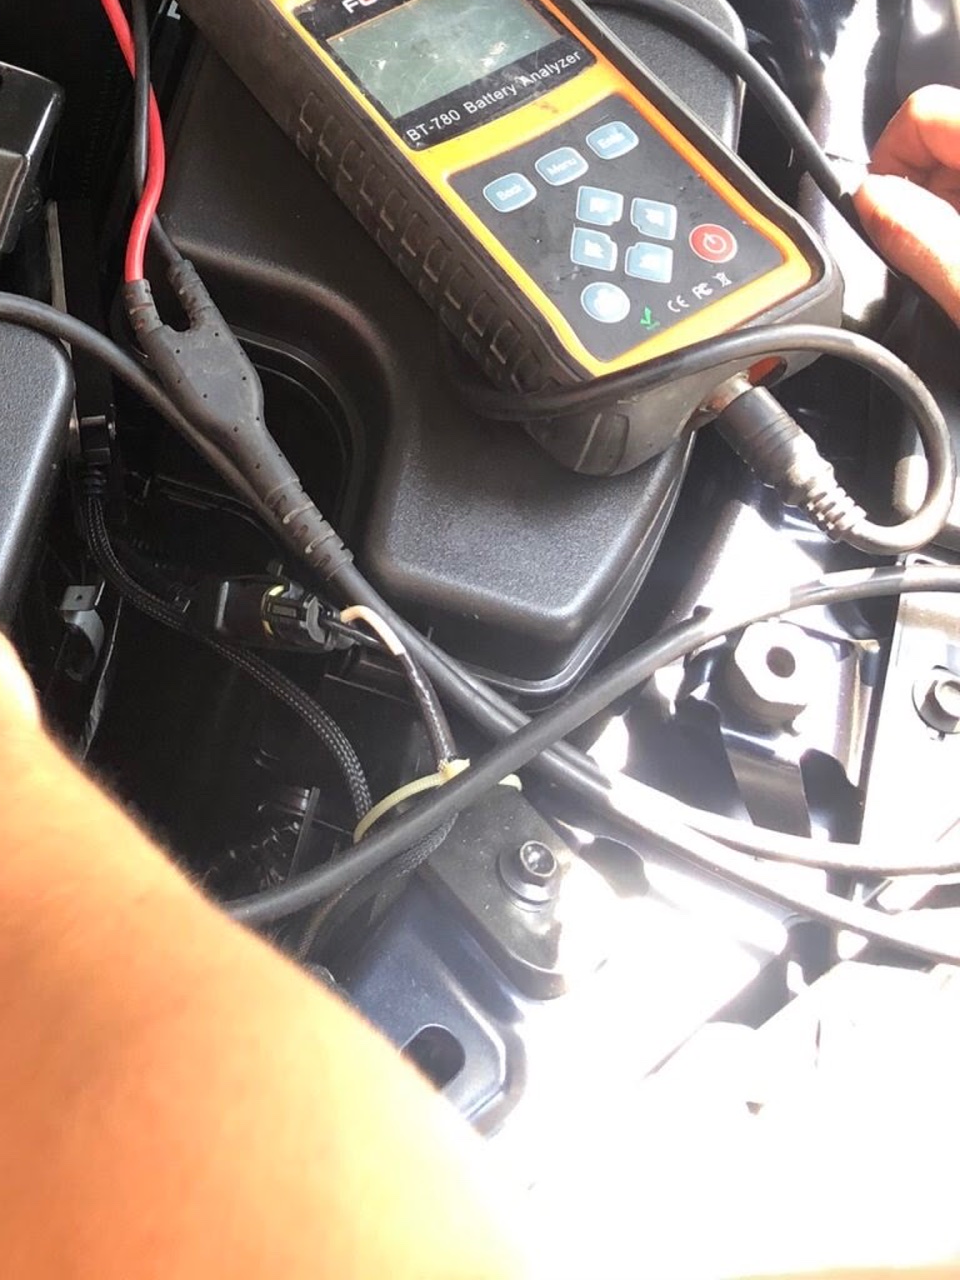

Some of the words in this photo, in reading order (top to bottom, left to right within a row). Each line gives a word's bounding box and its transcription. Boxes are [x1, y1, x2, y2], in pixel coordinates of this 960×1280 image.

[406, 109, 461, 142] BT-780
[463, 84, 518, 114] Battery
[520, 51, 582, 87] Analyzer
